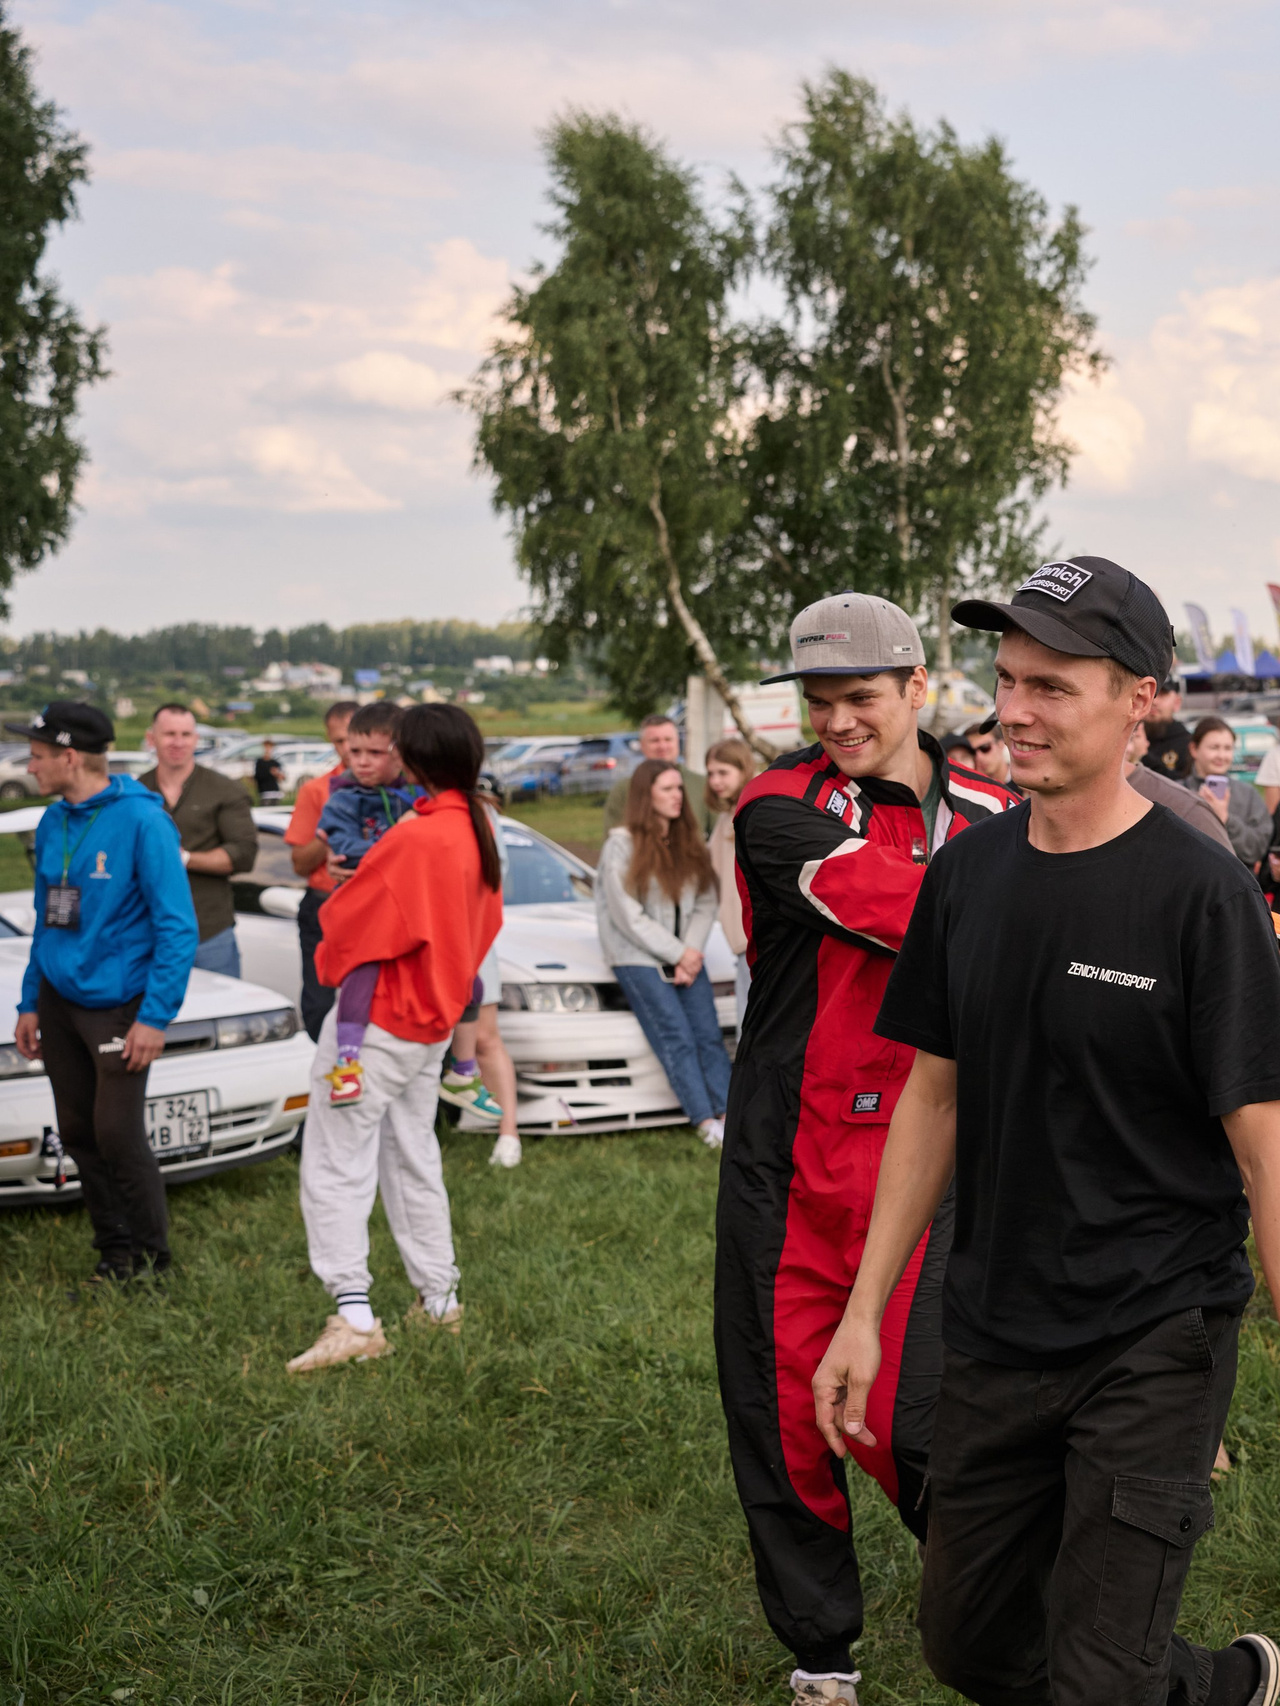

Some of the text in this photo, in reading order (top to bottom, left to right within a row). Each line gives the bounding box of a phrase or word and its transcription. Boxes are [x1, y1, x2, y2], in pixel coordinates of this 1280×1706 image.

[831, 792, 845, 814] OMP
[1067, 962, 1157, 991] ZENICH MOTOSPORT
[166, 1097, 198, 1119] 324
[856, 1097, 878, 1108] OMP
